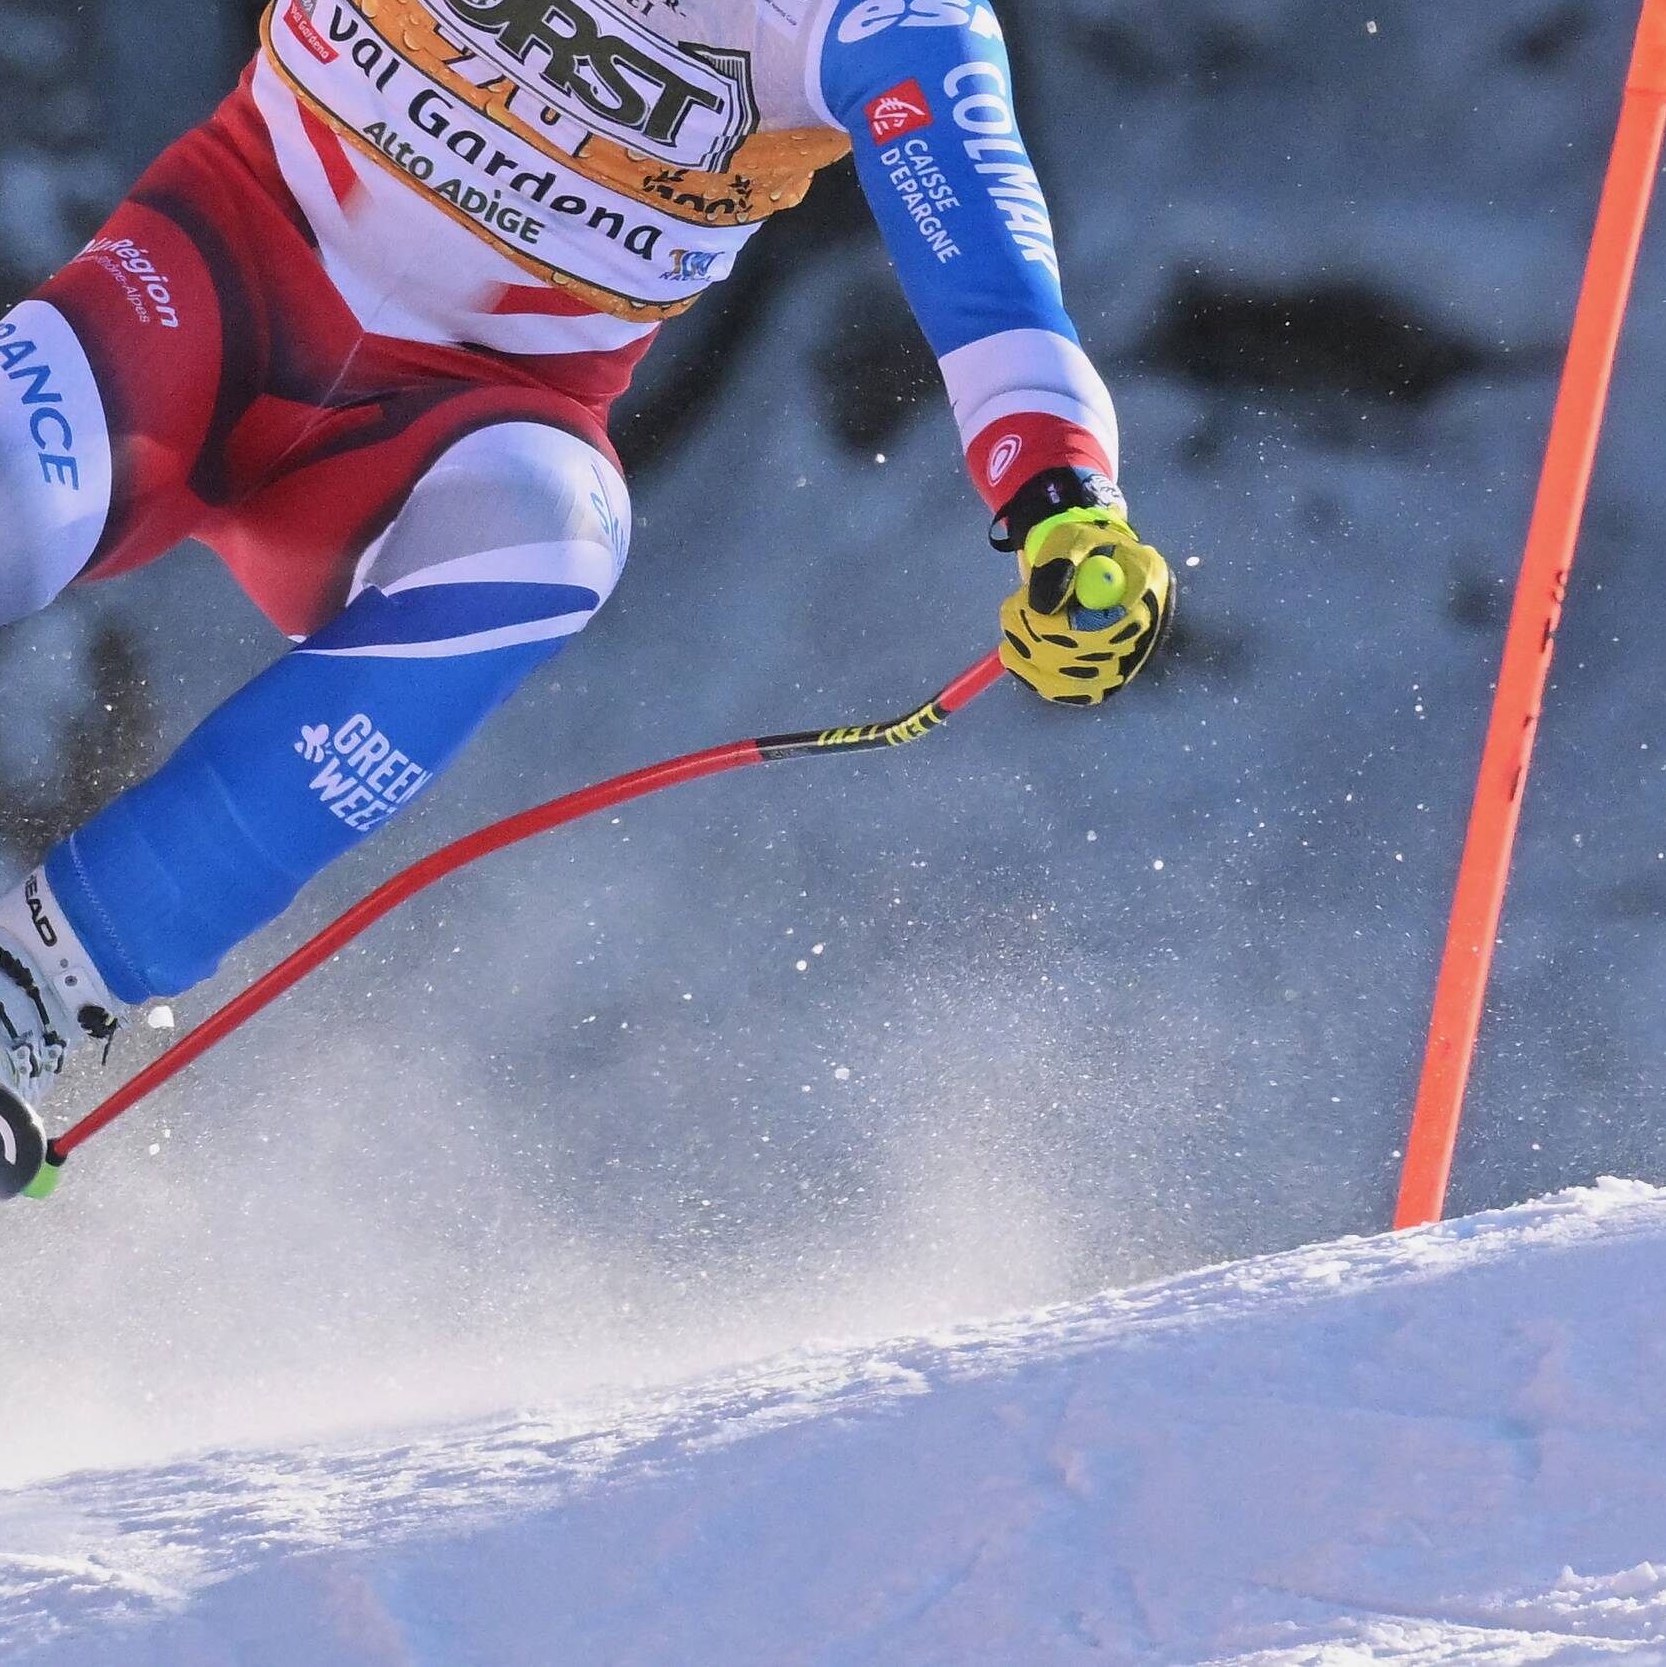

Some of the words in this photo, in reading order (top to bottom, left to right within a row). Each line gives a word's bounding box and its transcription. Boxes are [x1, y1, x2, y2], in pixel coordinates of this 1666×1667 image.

[408, 89, 663, 260] Gardena
[880, 146, 962, 264] D'EPARGNE
[904, 139, 961, 213] CAISSE
[105, 238, 179, 328] Région
[334, 713, 434, 804] GREEN
[24, 874, 58, 947] EAD
